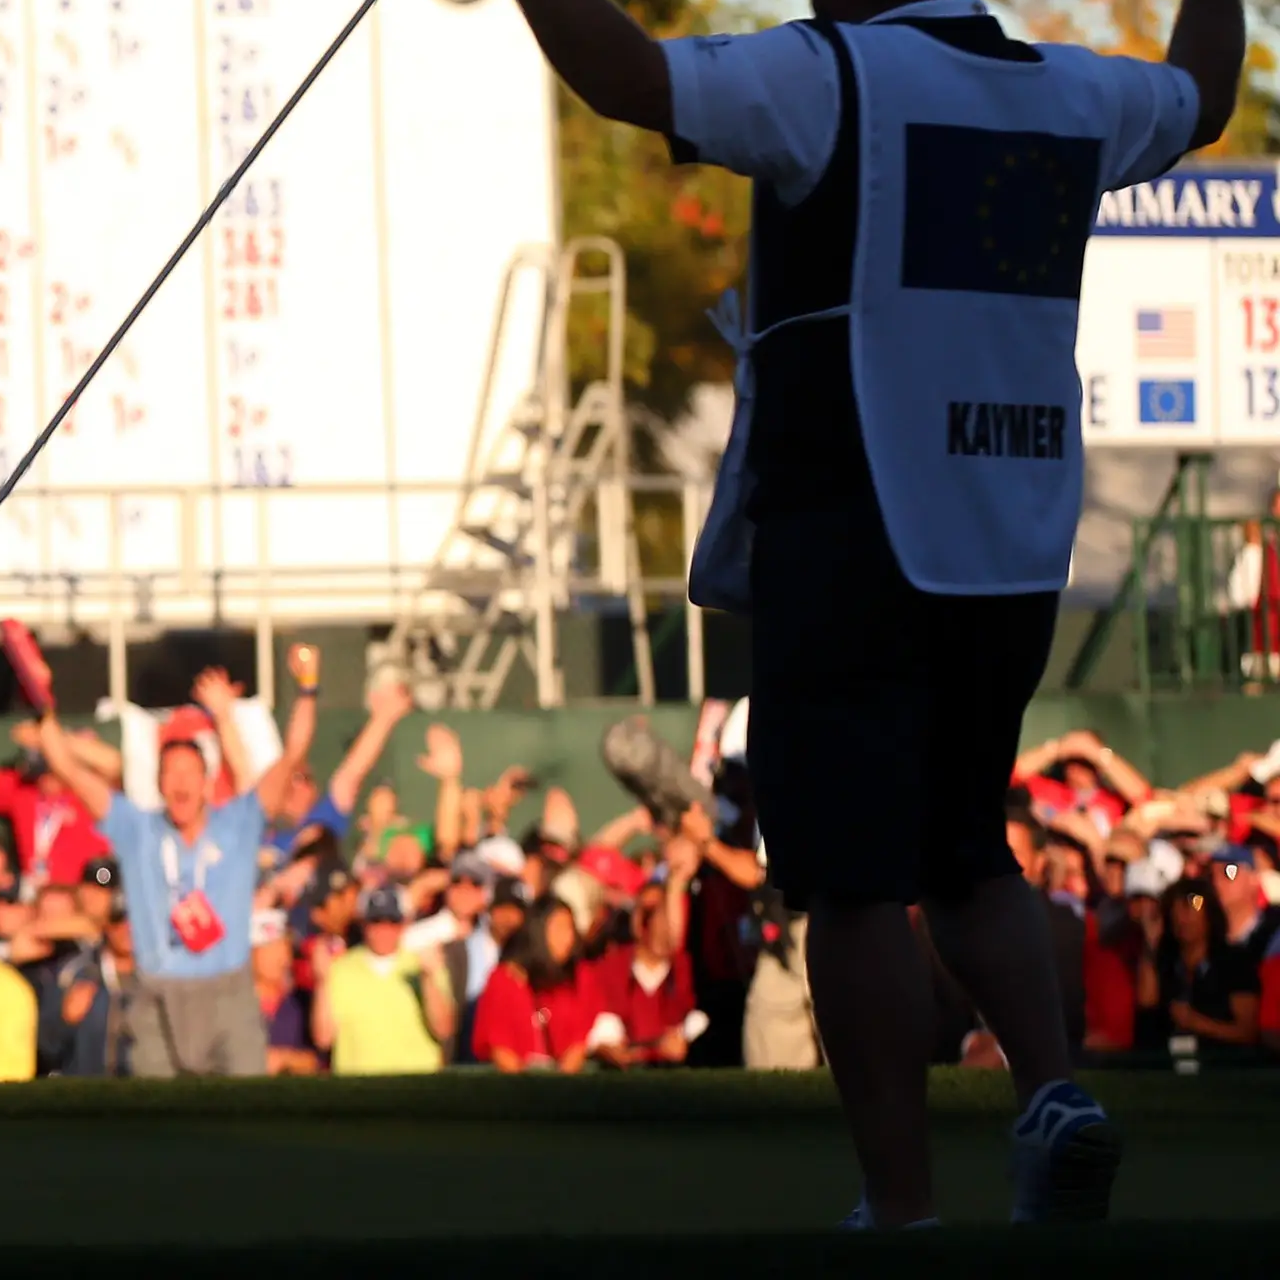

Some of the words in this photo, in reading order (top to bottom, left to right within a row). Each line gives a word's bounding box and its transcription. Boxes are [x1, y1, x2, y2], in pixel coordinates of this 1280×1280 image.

[1095, 179, 1262, 227] MMARY
[1241, 297, 1280, 352] 13
[947, 402, 1066, 460] KAYMER
